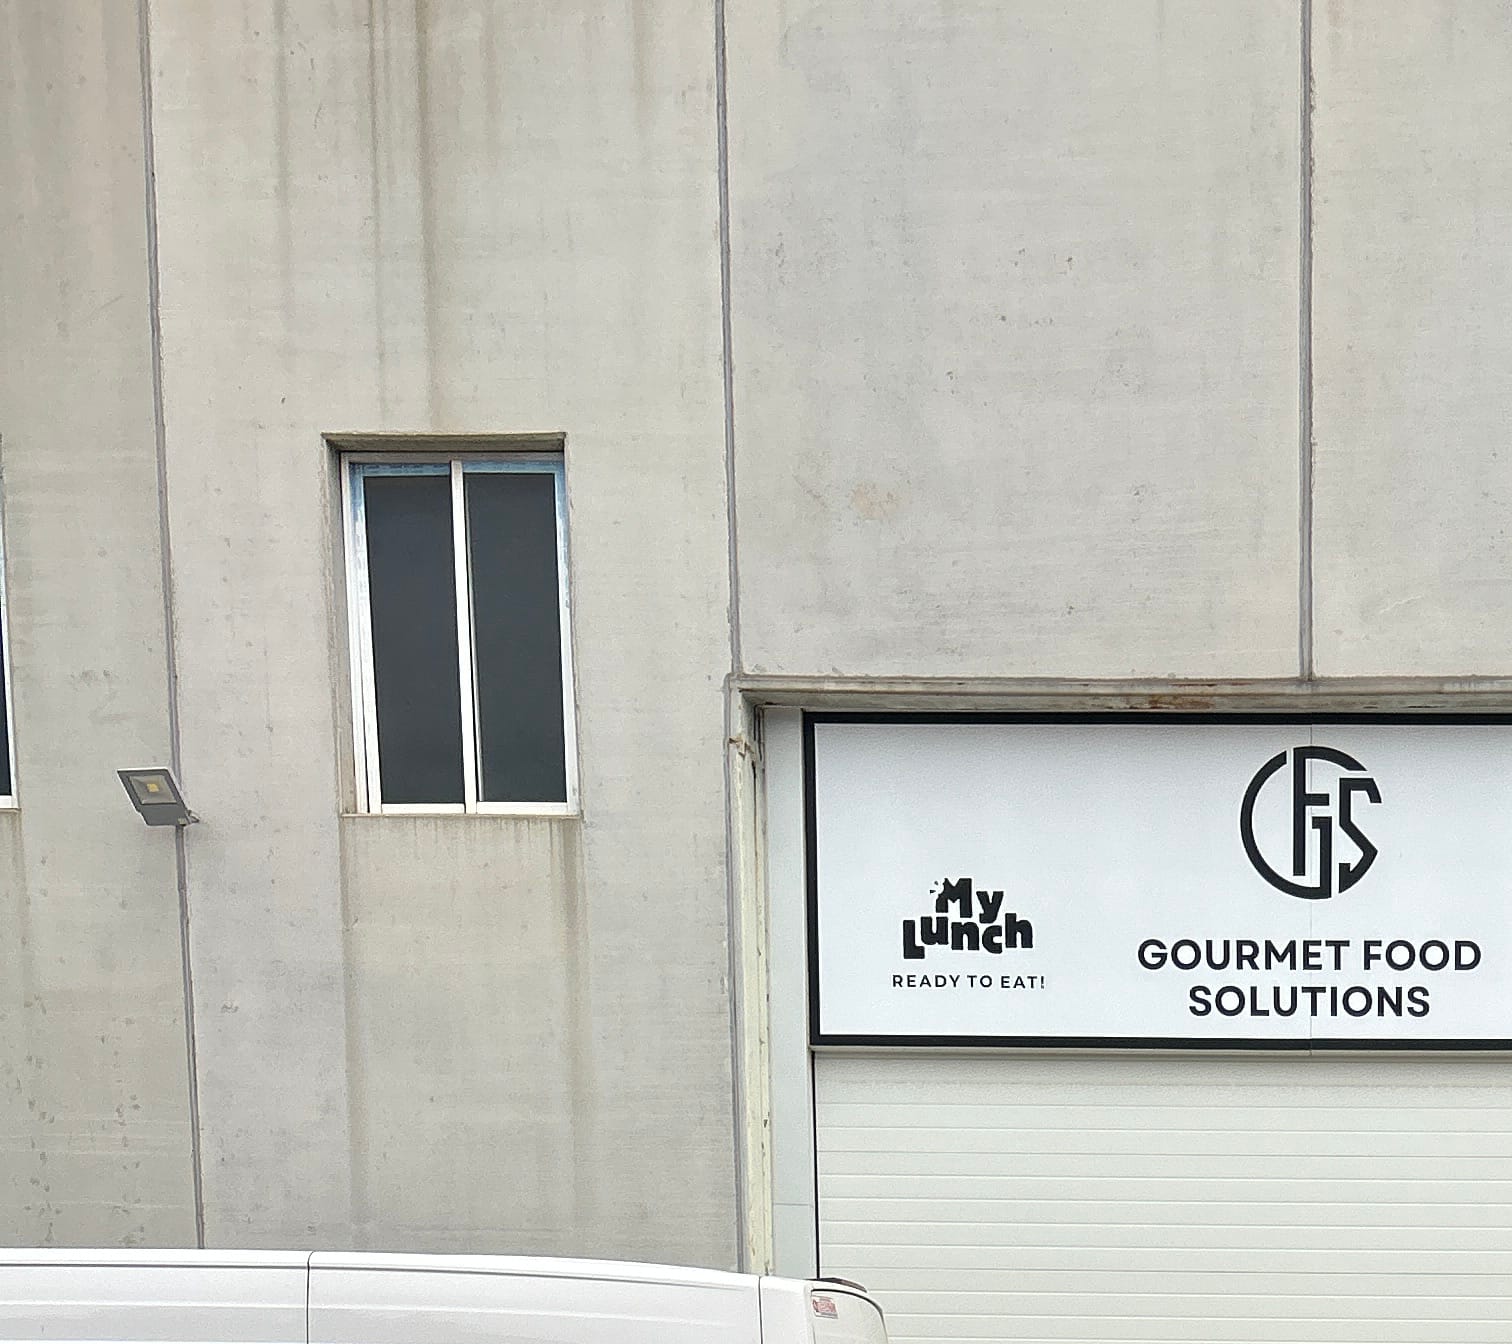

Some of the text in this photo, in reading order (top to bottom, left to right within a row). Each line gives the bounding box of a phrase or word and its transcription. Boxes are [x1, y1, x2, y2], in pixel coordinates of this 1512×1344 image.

[933, 877, 1005, 924] My
[902, 912, 1034, 960] Lunch
[1137, 938, 1482, 972] GOURMET FOOD
[892, 974, 1046, 989] READY TO EAT!
[1188, 985, 1431, 1018] SOLUTIONS
